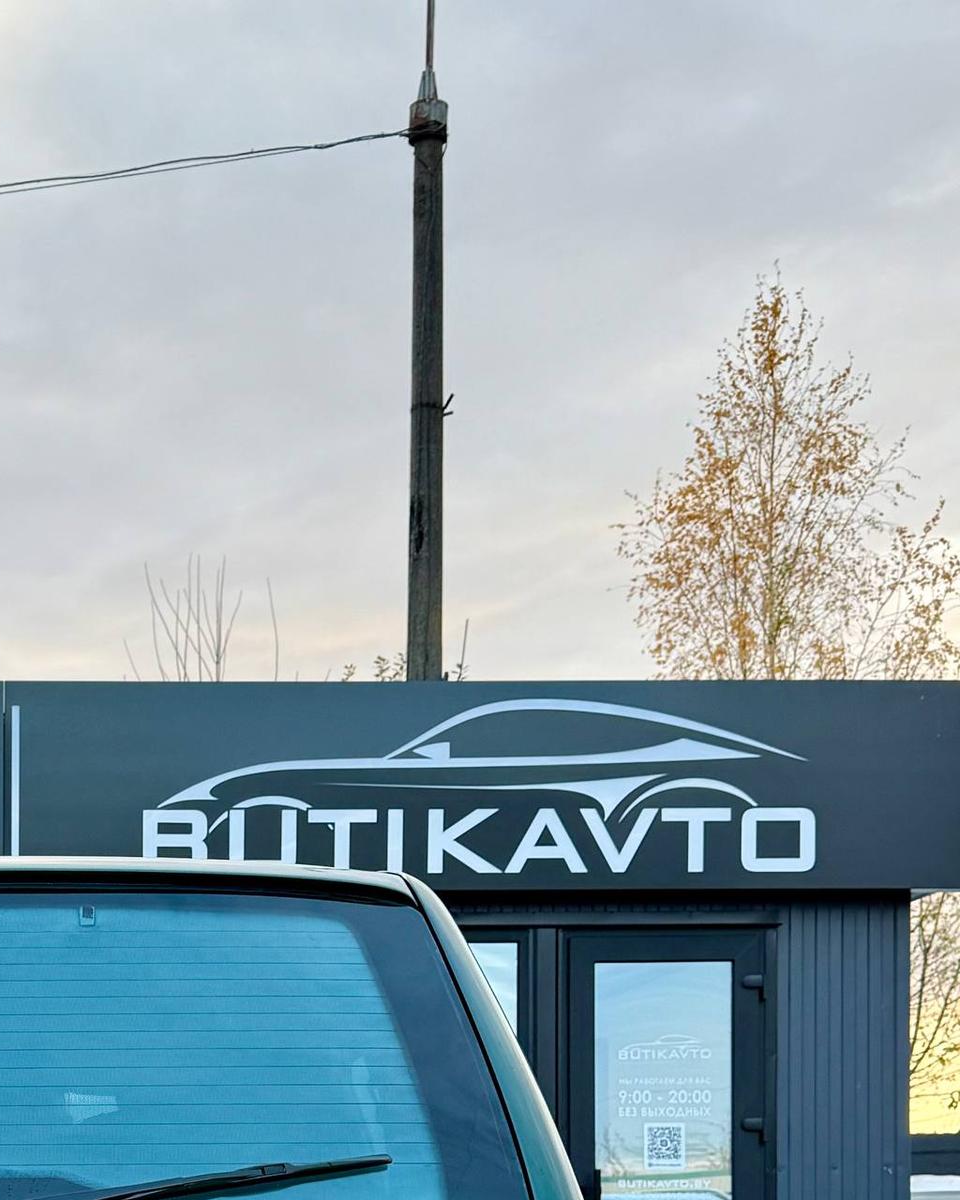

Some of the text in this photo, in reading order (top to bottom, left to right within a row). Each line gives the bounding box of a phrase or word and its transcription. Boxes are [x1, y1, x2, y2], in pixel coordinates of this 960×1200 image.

[142, 808, 816, 874] BUTIKAVTO
[618, 1049, 712, 1060] BUTIKAVTO
[618, 1089, 652, 1104] 9:00
[668, 1089, 712, 1104] 20:00
[618, 1107, 711, 1118] БЕЗ ВЫХОДНЫХ
[618, 1179, 711, 1188] BUTIKAVTO.BY
